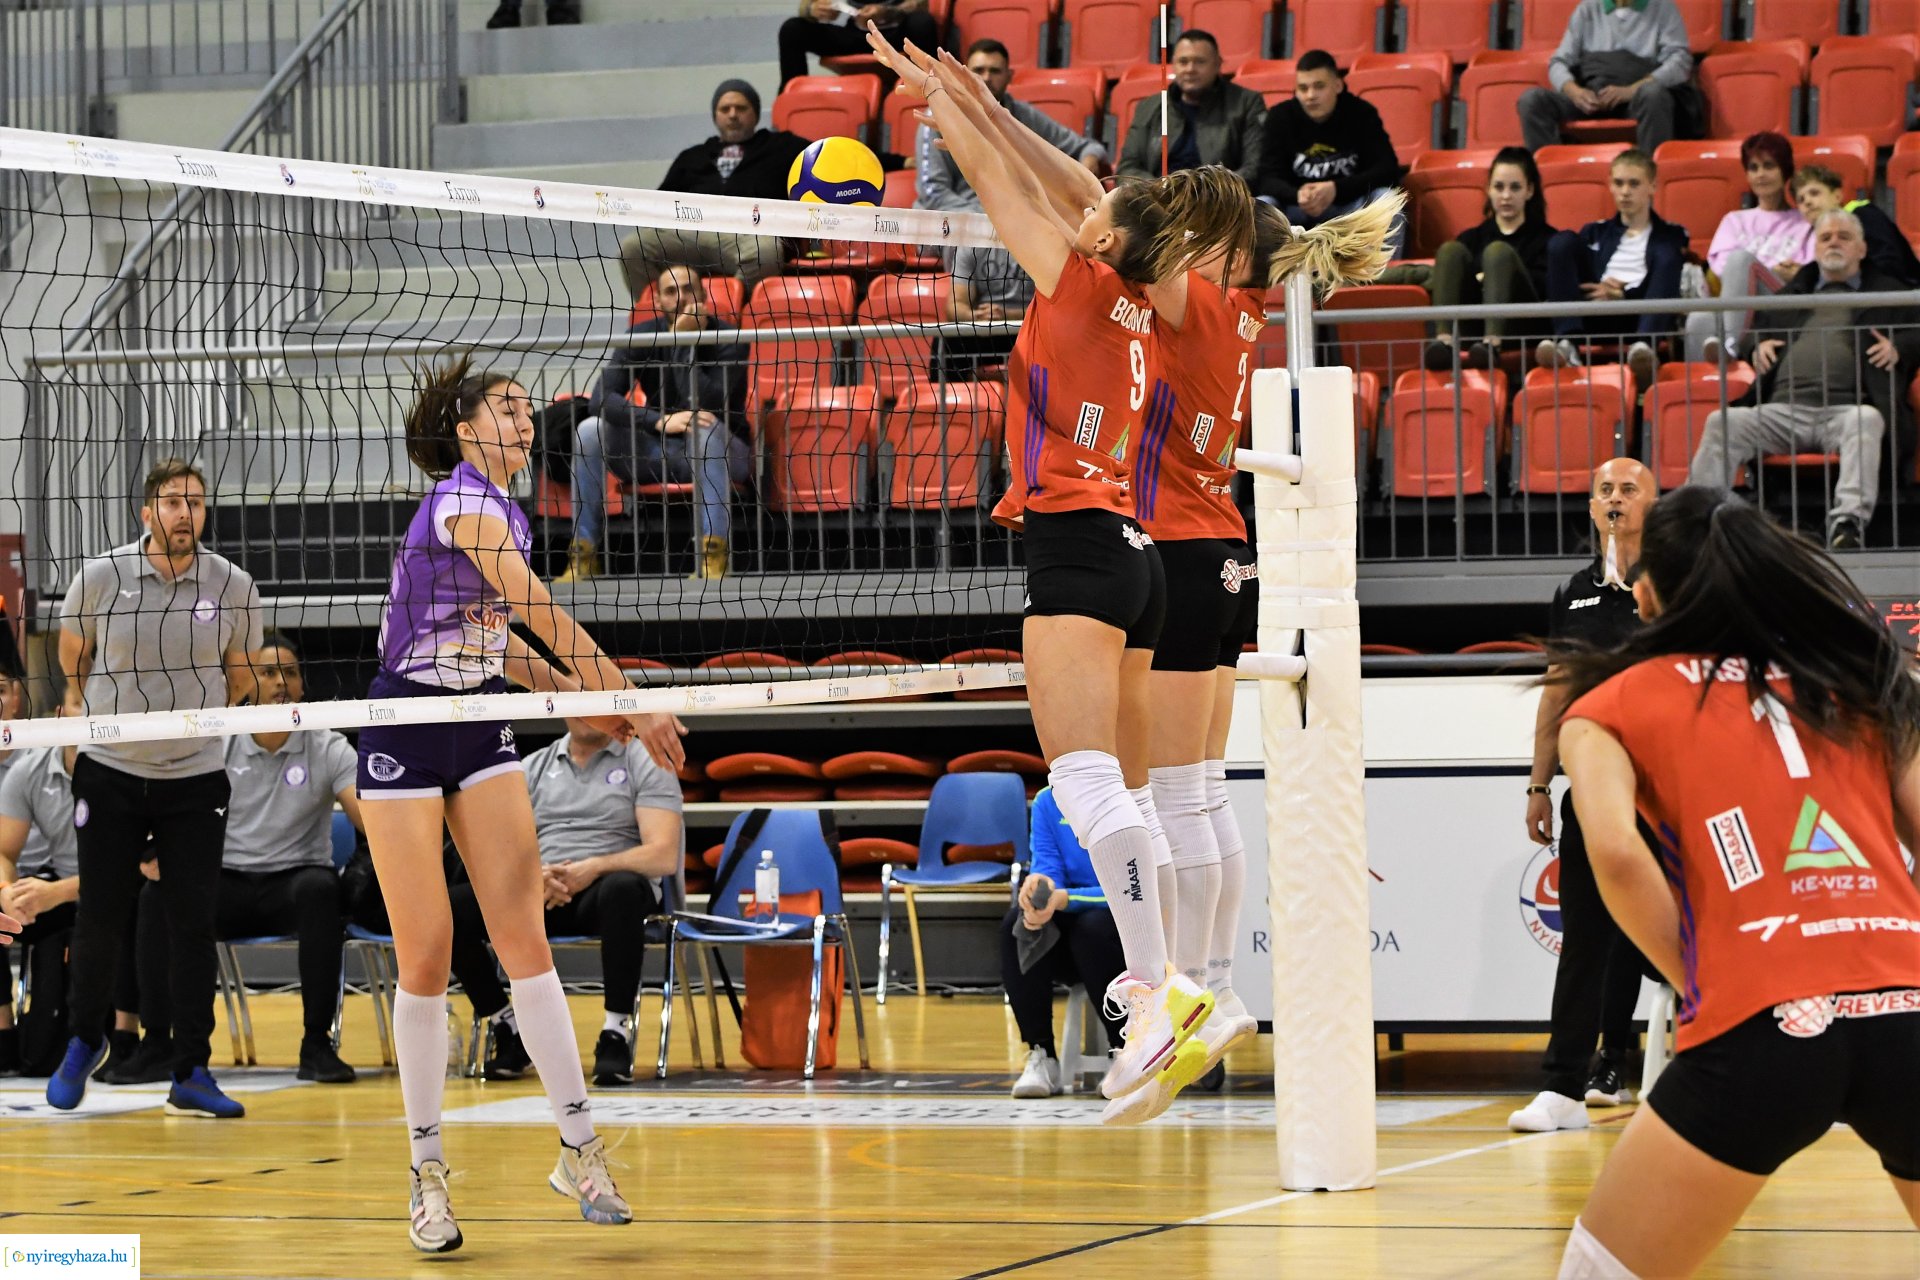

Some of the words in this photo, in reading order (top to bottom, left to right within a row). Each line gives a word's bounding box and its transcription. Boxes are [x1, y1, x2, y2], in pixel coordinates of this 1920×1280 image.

[174, 155, 218, 178] FATUM
[444, 181, 481, 202] FATUM
[835, 187, 862, 198] V200W
[674, 200, 704, 221] FATUM
[874, 214, 900, 233] FATUM
[1129, 339, 1146, 411] 9
[1231, 352, 1249, 422] 2
[1080, 406, 1097, 448] TRABAG
[1195, 416, 1210, 449] ABAG
[828, 683, 849, 698] FATUM
[368, 703, 396, 721] FATUM
[613, 694, 638, 710] FATUM
[89, 720, 121, 739] FATUM
[1750, 692, 1811, 779] 1
[1720, 816, 1752, 881] STRABAG
[1128, 857, 1143, 902] MIKASA
[1857, 874, 1878, 890] 21
